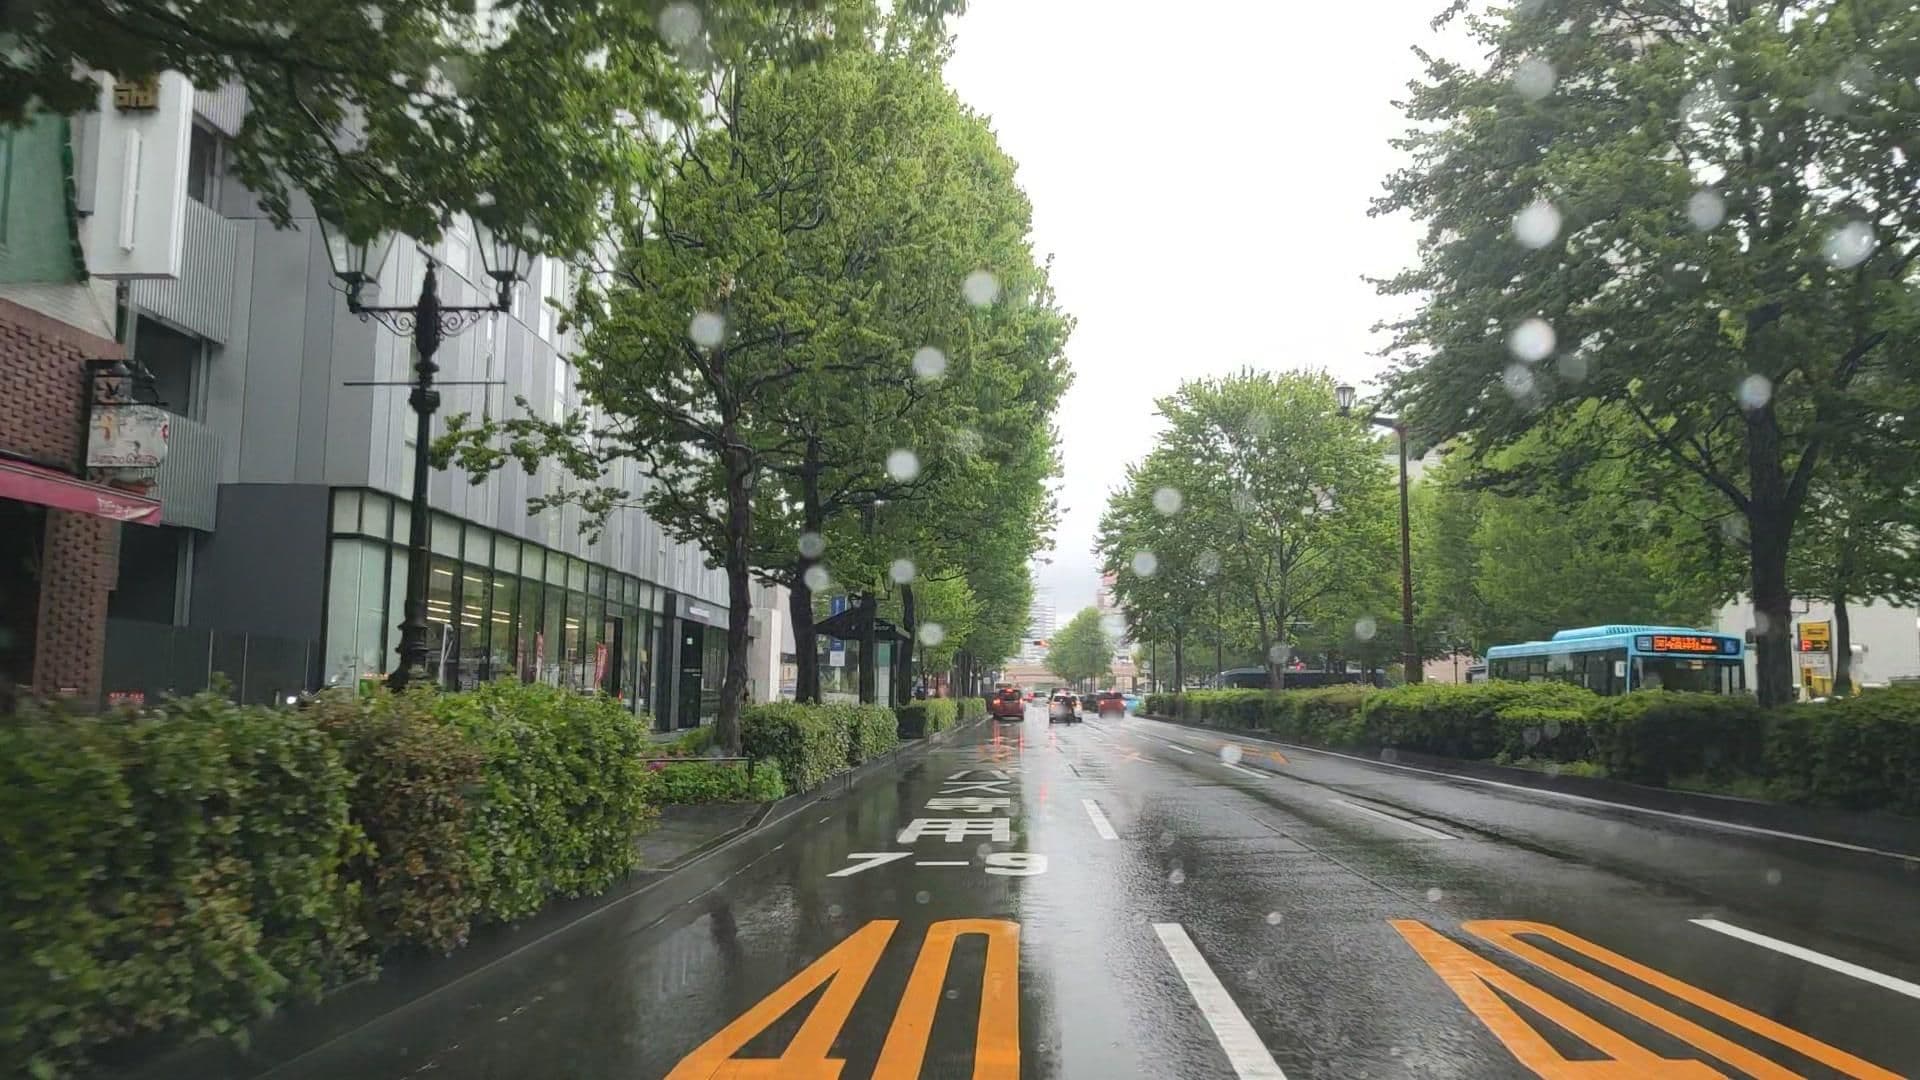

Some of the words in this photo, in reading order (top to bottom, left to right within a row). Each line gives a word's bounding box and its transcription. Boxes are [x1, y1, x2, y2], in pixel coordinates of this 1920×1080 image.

[826, 852, 1049, 876] 7-9
[662, 918, 1021, 1080] 40
[1390, 918, 1915, 1080] 40
